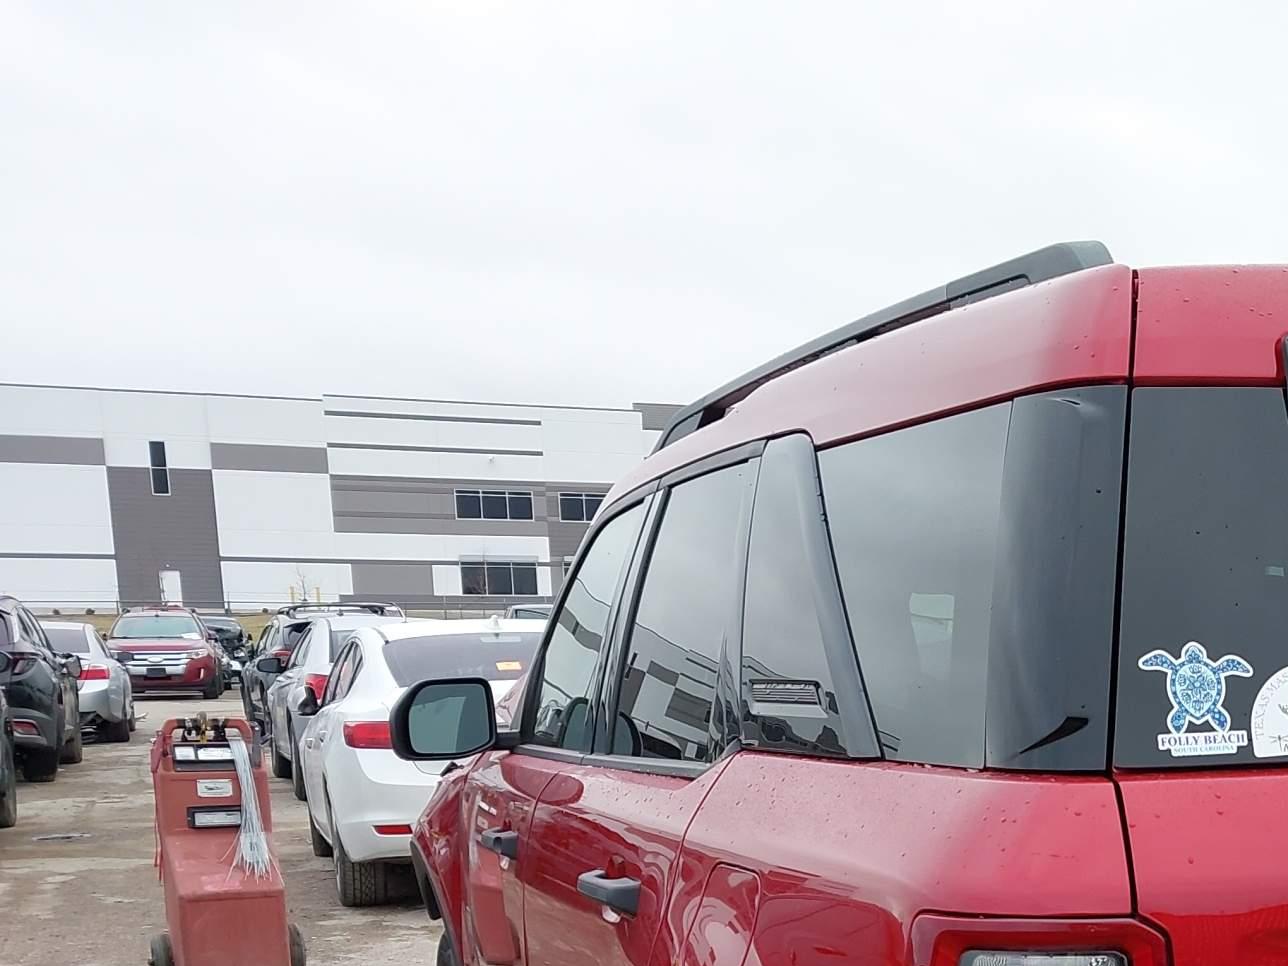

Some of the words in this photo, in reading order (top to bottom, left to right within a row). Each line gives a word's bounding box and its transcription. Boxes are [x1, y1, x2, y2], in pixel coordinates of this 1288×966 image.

[1254, 694, 1271, 740] TEXAS
[1161, 735, 1200, 747] FOLLY
[1204, 733, 1245, 745] BEACH
[1173, 746, 1198, 754] SOUTH
